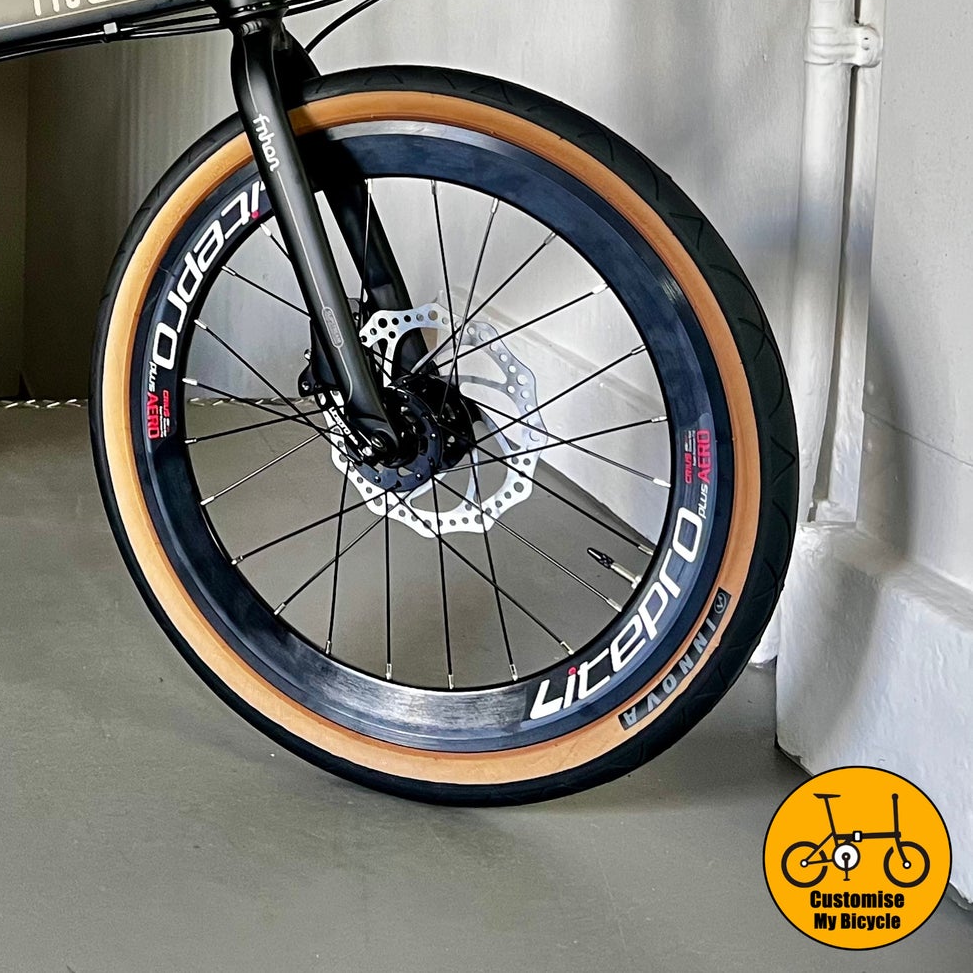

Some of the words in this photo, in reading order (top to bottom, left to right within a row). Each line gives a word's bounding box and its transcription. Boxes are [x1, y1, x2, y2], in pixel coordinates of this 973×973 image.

[253, 113, 280, 172] fnhon
[144, 392, 159, 439] AERO
[529, 506, 704, 720] Litepro
[698, 429, 711, 484] AERO
[623, 617, 717, 728] INNOVA
